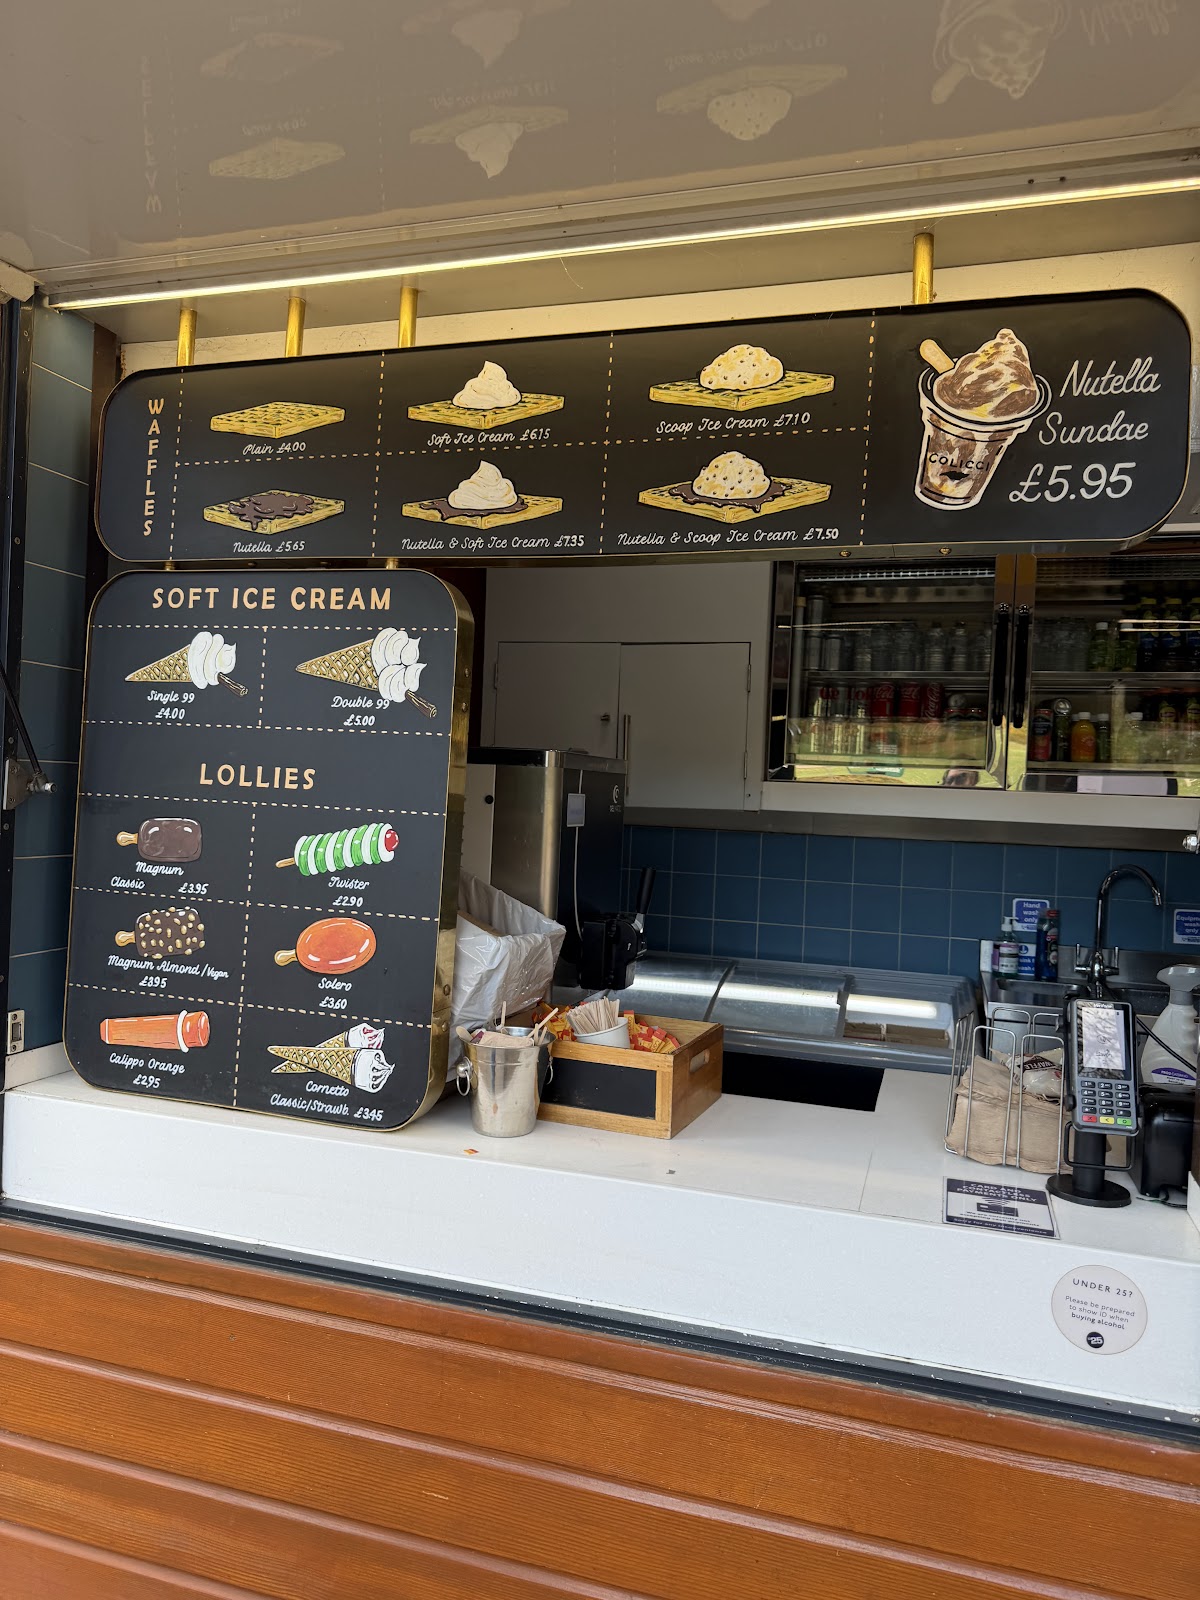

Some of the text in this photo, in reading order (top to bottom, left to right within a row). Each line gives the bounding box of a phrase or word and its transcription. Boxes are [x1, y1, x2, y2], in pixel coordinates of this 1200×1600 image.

[1059, 356, 1161, 398] Nutella
[656, 412, 811, 435] Scoop Ice Cream £7.10
[1038, 410, 1149, 445] Sundae
[243, 442, 306, 455] Plain £4.00
[427, 433, 451, 448] Soft
[454, 433, 474, 444] Ice
[478, 432, 515, 443] Cream
[143, 398, 164, 536] WAFFLES
[928, 452, 990, 472] COLICCI
[1008, 462, 1137, 502] £5.95
[401, 535, 585, 552] Nutella & Soft Ice Cream £7.35
[617, 527, 839, 546] Nutella & Scoop Ice Cream £7.50
[233, 541, 272, 552] Nutella
[152, 587, 391, 610] SOFT ICE CREAM
[147, 689, 195, 704] Single 99
[331, 695, 390, 709] Double 99
[155, 707, 185, 720] £4.00
[343, 713, 375, 727] £5.00
[199, 763, 316, 790] LOLLIES
[136, 861, 184, 876] Magnum
[110, 876, 209, 895] Classic £3.95
[328, 876, 370, 890] Twister
[108, 954, 155, 970] Magnum
[156, 960, 201, 976] Almond
[318, 977, 353, 991] Solero
[109, 1052, 186, 1076] Calippo Orange
[305, 1080, 350, 1097] Cornetto
[270, 1093, 350, 1116] Classic/Strawb.
[956, 1187, 1008, 1197] PAYMENTS
[962, 1185, 1030, 1197] CONTACTLESS
[1072, 1278, 1133, 1298] UNDER 25?
[1065, 1295, 1088, 1306] Please
[1101, 1304, 1135, 1317] prepared
[1078, 1306, 1098, 1316] show
[1109, 1315, 1129, 1323] when
[1071, 1312, 1125, 1330] buying alcohol
